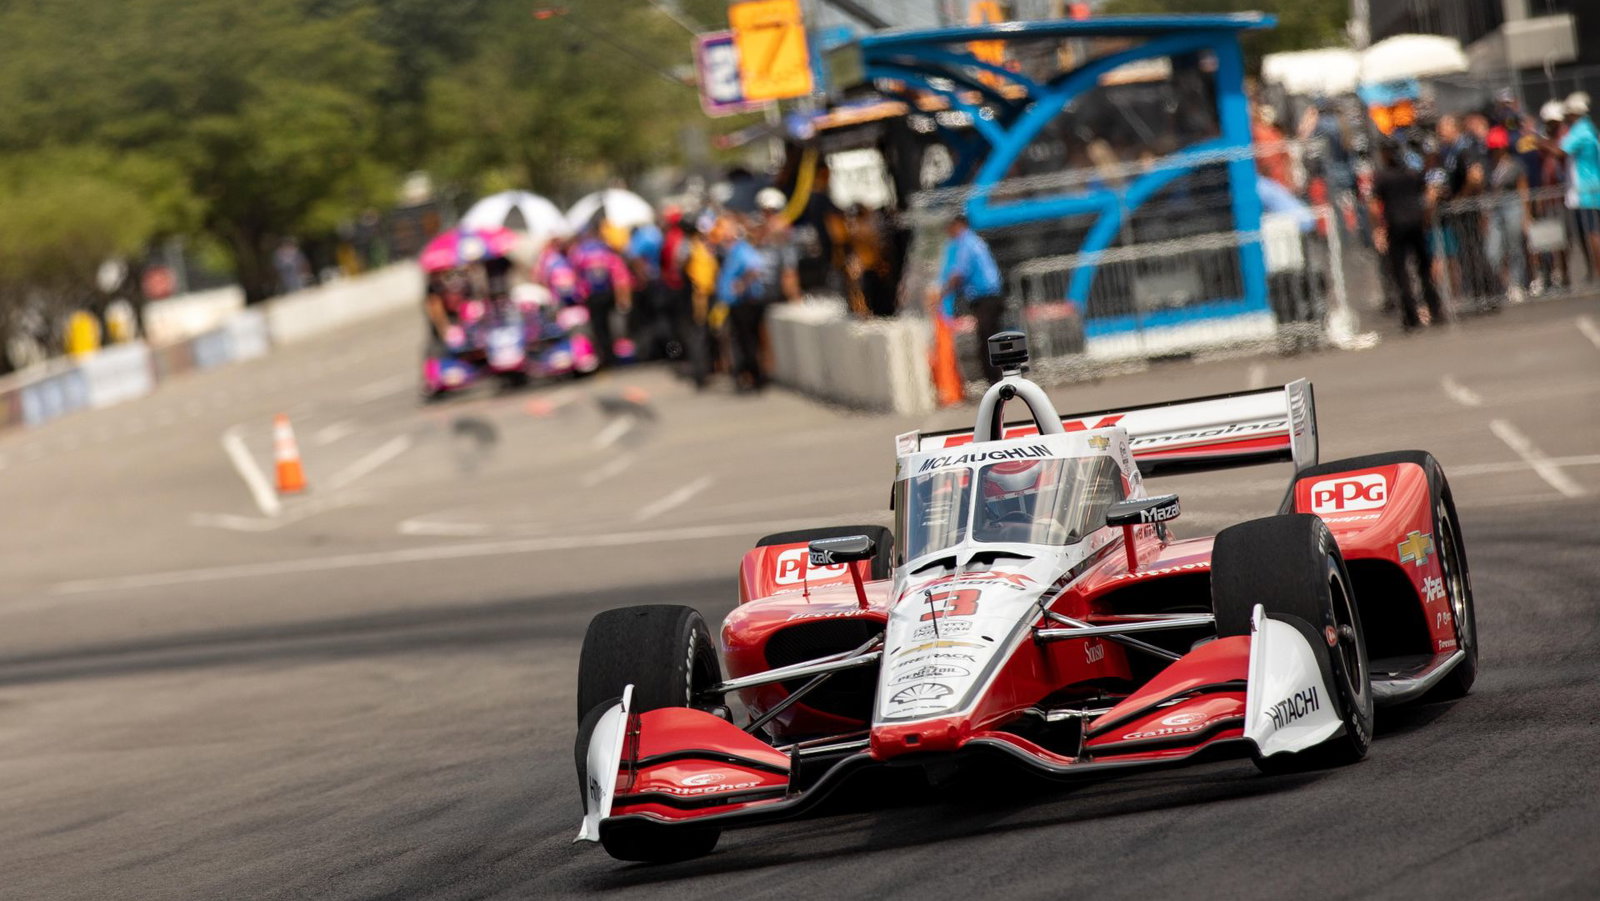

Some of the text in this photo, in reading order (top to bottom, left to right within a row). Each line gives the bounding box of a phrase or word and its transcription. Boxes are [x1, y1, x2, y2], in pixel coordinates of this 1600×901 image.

[919, 444, 1054, 473] MCLAUGHLIN
[1314, 481, 1384, 509] PPG
[920, 588, 983, 622] 3
[1265, 685, 1320, 731] HITACHI
